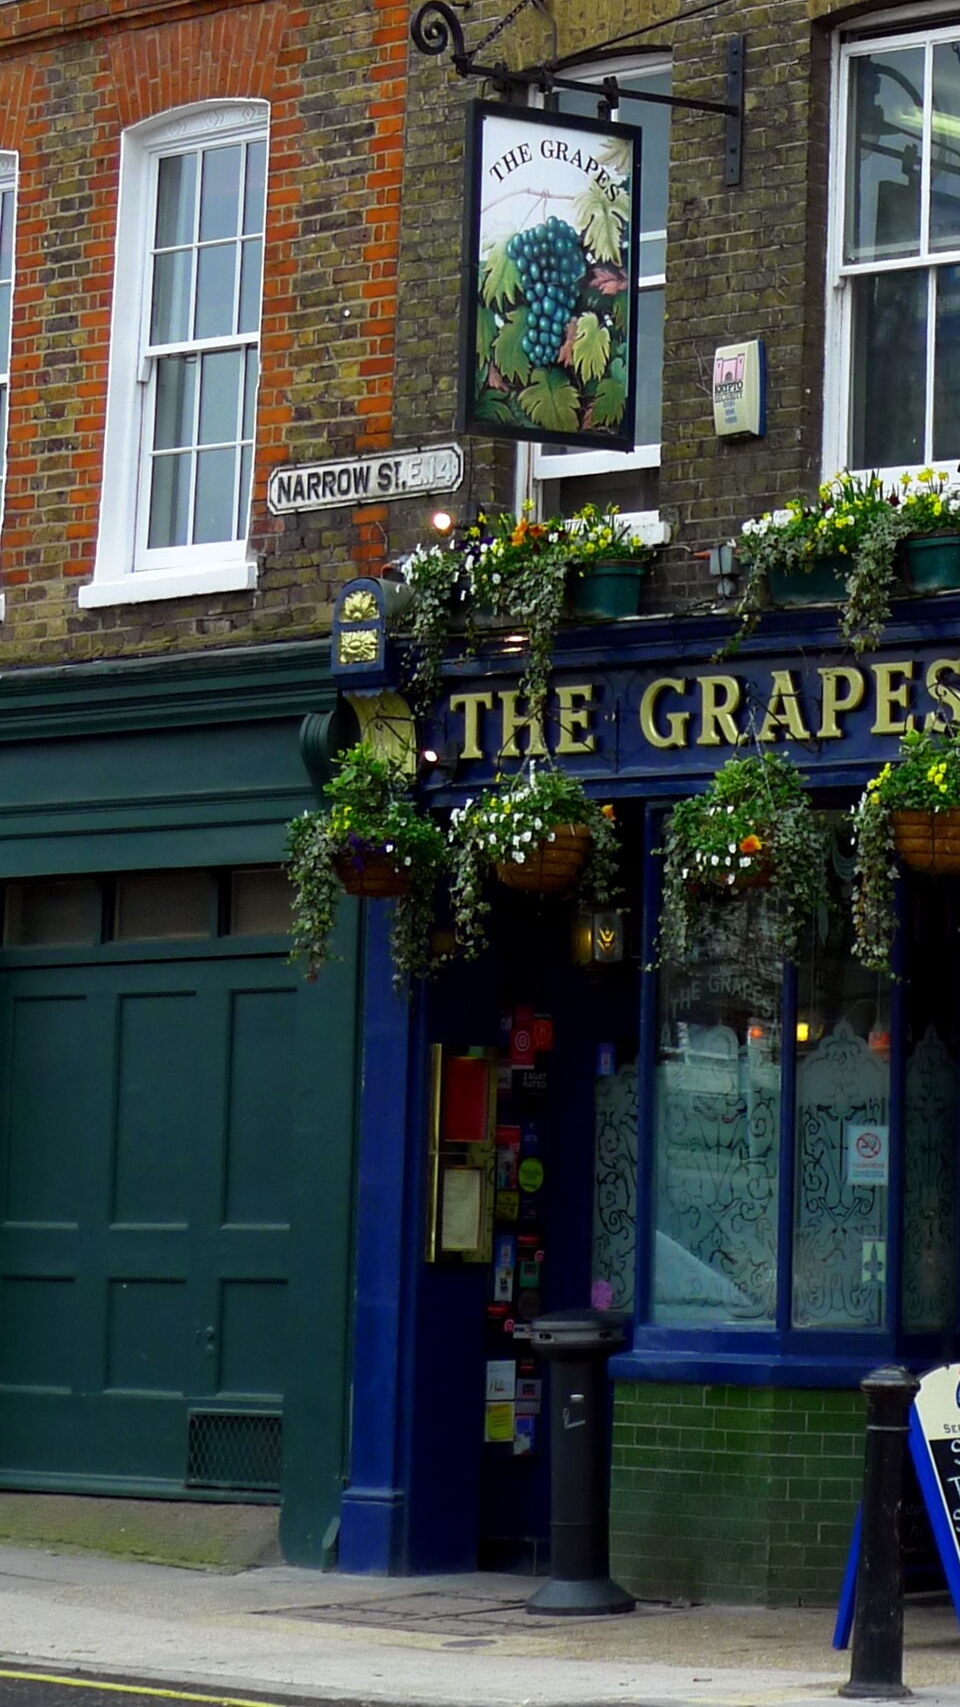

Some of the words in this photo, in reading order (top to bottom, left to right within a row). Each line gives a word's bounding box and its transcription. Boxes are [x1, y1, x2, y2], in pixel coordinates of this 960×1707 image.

[489, 143, 533, 184] THE
[540, 139, 620, 203] GRAPES
[715, 380, 744, 394] KRYPTO
[276, 465, 371, 504] NARROW
[377, 461, 407, 491] ST.
[449, 684, 597, 760] THE
[670, 980, 701, 1020] THE
[707, 973, 774, 1019] GRAPES
